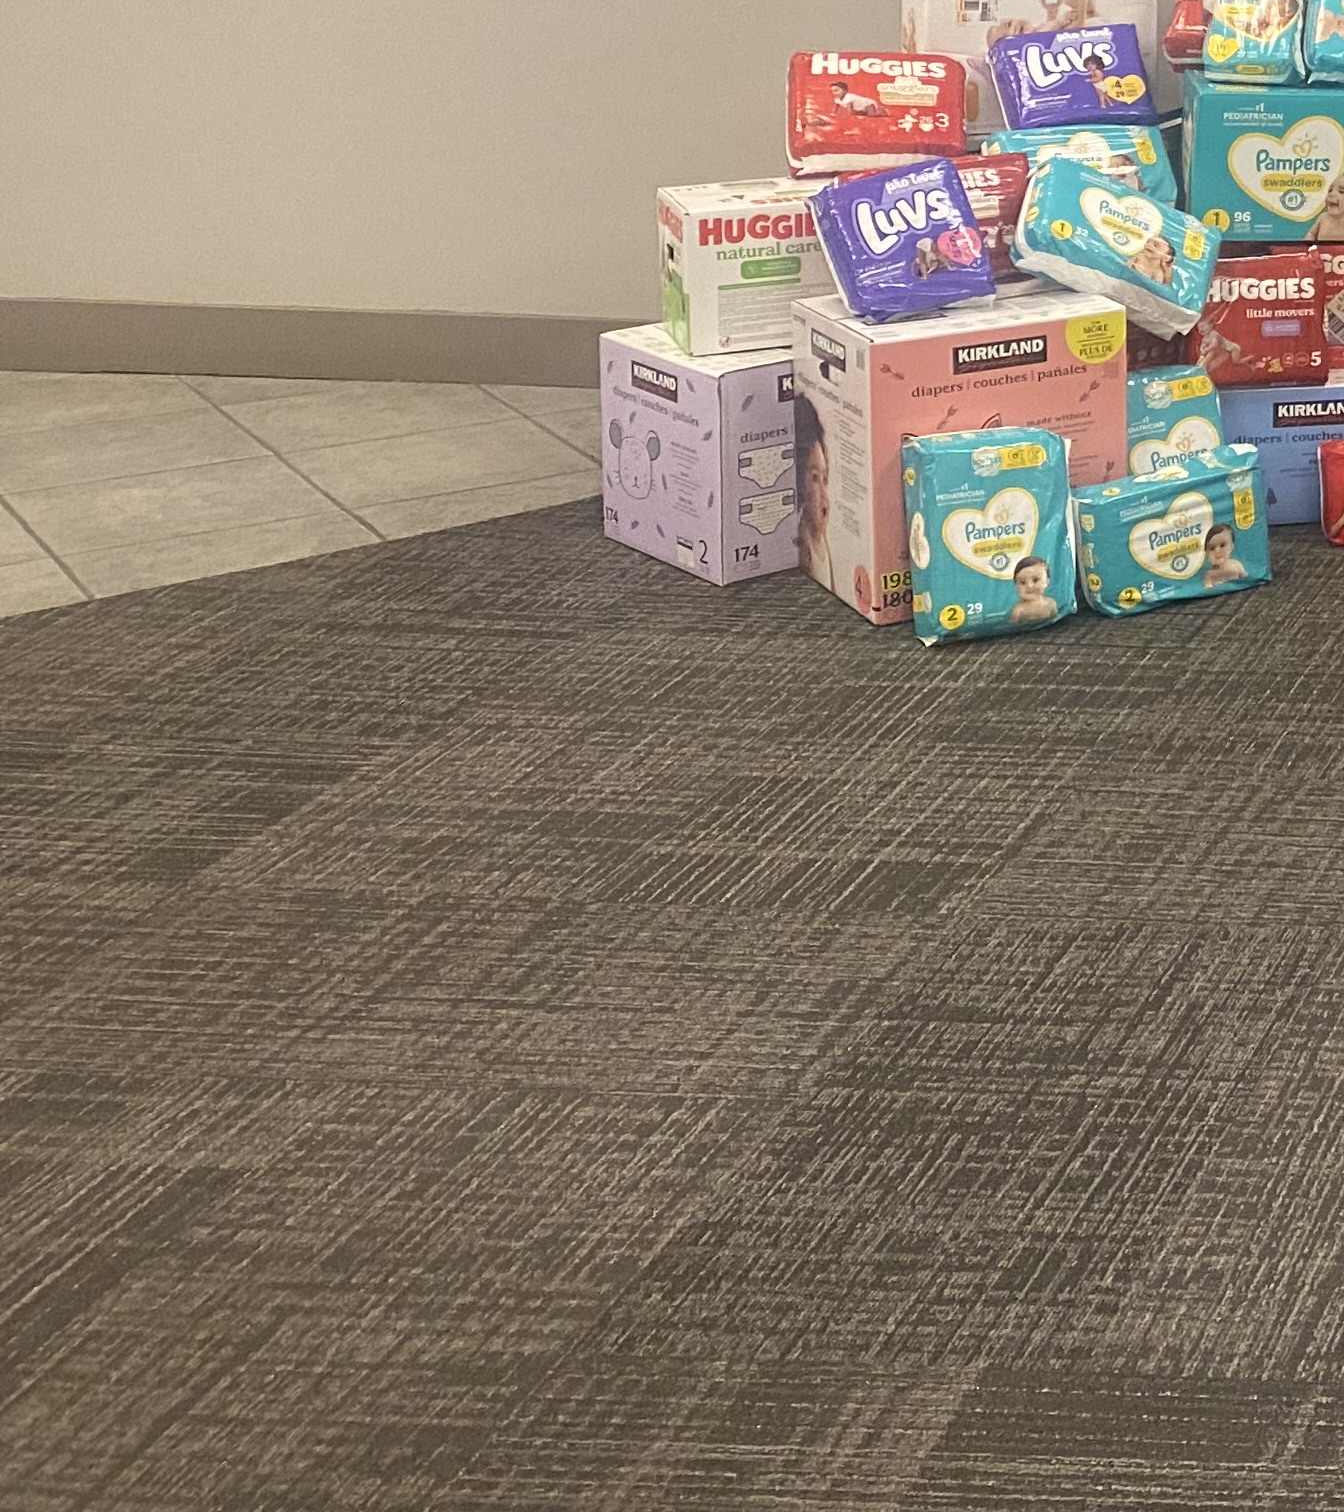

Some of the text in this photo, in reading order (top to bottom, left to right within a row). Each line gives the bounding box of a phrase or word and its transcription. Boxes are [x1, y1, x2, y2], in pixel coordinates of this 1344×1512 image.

[811, 53, 946, 78] HUGGIES
[935, 113, 950, 128] 3
[1223, 112, 1284, 121] PEDIATRICIAN
[1256, 149, 1331, 174] Pampers
[1263, 177, 1323, 188] swaddlers
[1100, 200, 1150, 232] Pampers
[1234, 212, 1251, 222] 96
[716, 243, 781, 260] natural
[1206, 278, 1315, 303] HUGGIES
[1246, 306, 1315, 319] little movers
[1083, 323, 1108, 334] MORE
[958, 339, 1045, 362] KIRKLAND
[1079, 346, 1101, 357] PLUS
[1310, 351, 1321, 366] 5
[633, 364, 676, 391] KIRKLAND
[911, 363, 1087, 399] diapers couches pañales
[740, 426, 788, 443] diapers
[1233, 432, 1283, 445] diapers
[1292, 429, 1344, 443] couches
[605, 507, 618, 524] 174
[965, 521, 1025, 542] Pampers
[1149, 523, 1202, 550] Pampers
[699, 540, 708, 564] 2
[734, 544, 760, 562] 174
[1126, 590, 1135, 601] 2
[947, 603, 983, 622] 2 29
